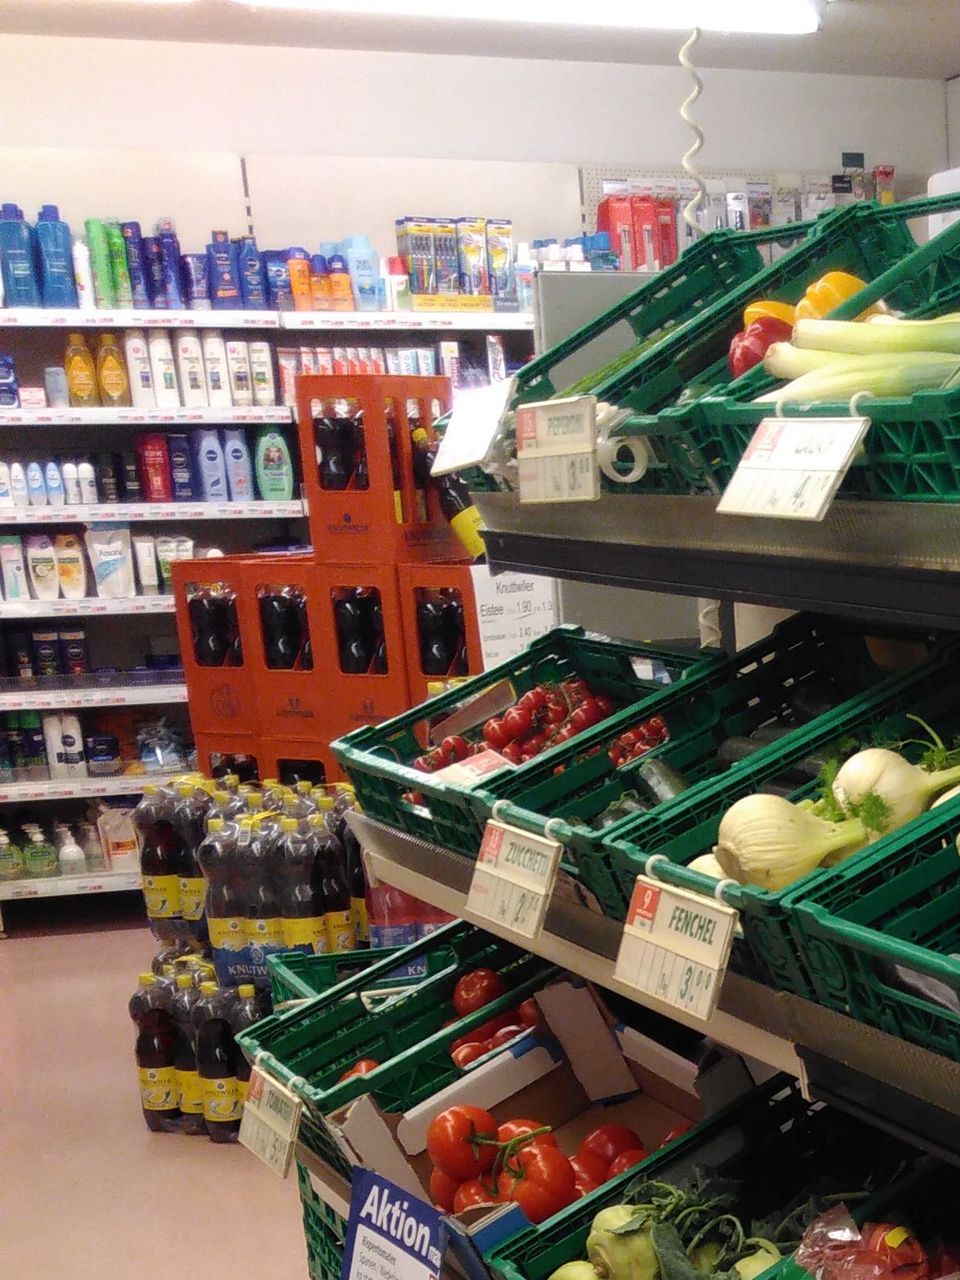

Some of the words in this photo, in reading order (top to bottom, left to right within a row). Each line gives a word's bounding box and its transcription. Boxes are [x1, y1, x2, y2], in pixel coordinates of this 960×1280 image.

[495, 581, 535, 595] Knuttwiler
[667, 905, 718, 947] FENCHEL
[359, 1184, 431, 1257] Aktion
